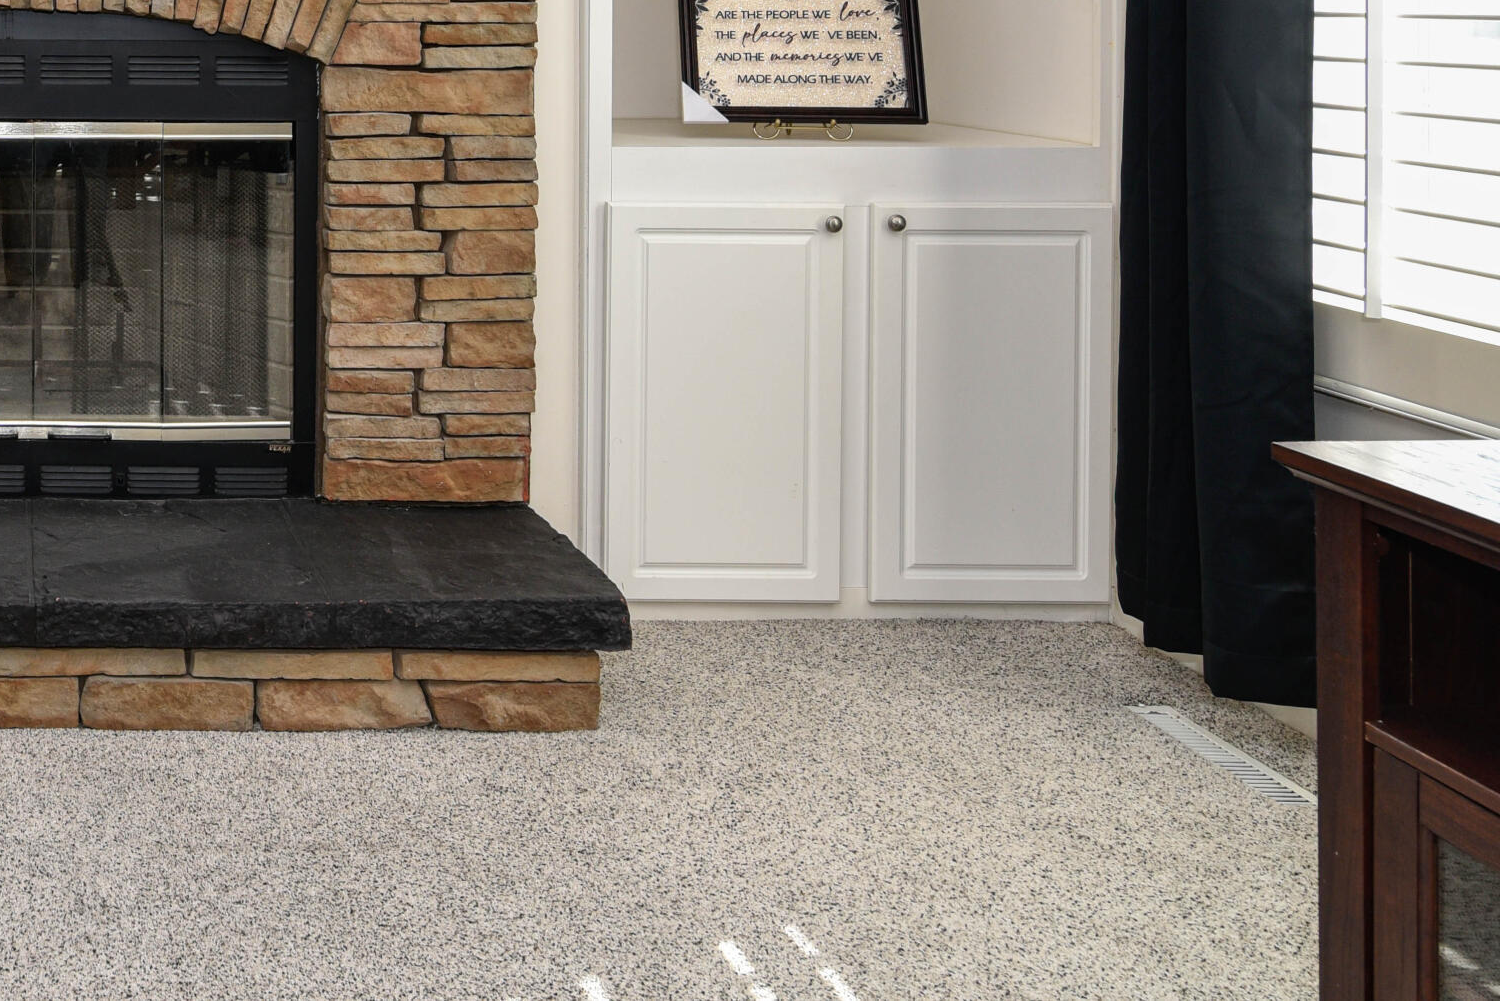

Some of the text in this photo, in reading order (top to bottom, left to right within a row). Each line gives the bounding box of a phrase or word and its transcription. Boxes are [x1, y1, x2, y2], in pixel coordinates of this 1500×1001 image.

[715, 10, 737, 19] ARE
[741, 10, 763, 19] THE
[766, 10, 809, 19] PEOPLE
[811, 10, 831, 19] WE
[715, 30, 736, 40] THE
[741, 23, 798, 47] places
[715, 52, 742, 62] AND
[743, 52, 764, 61] THE
[770, 51, 845, 67] memories
[737, 74, 873, 84] MADE ALONG THE WAY.
